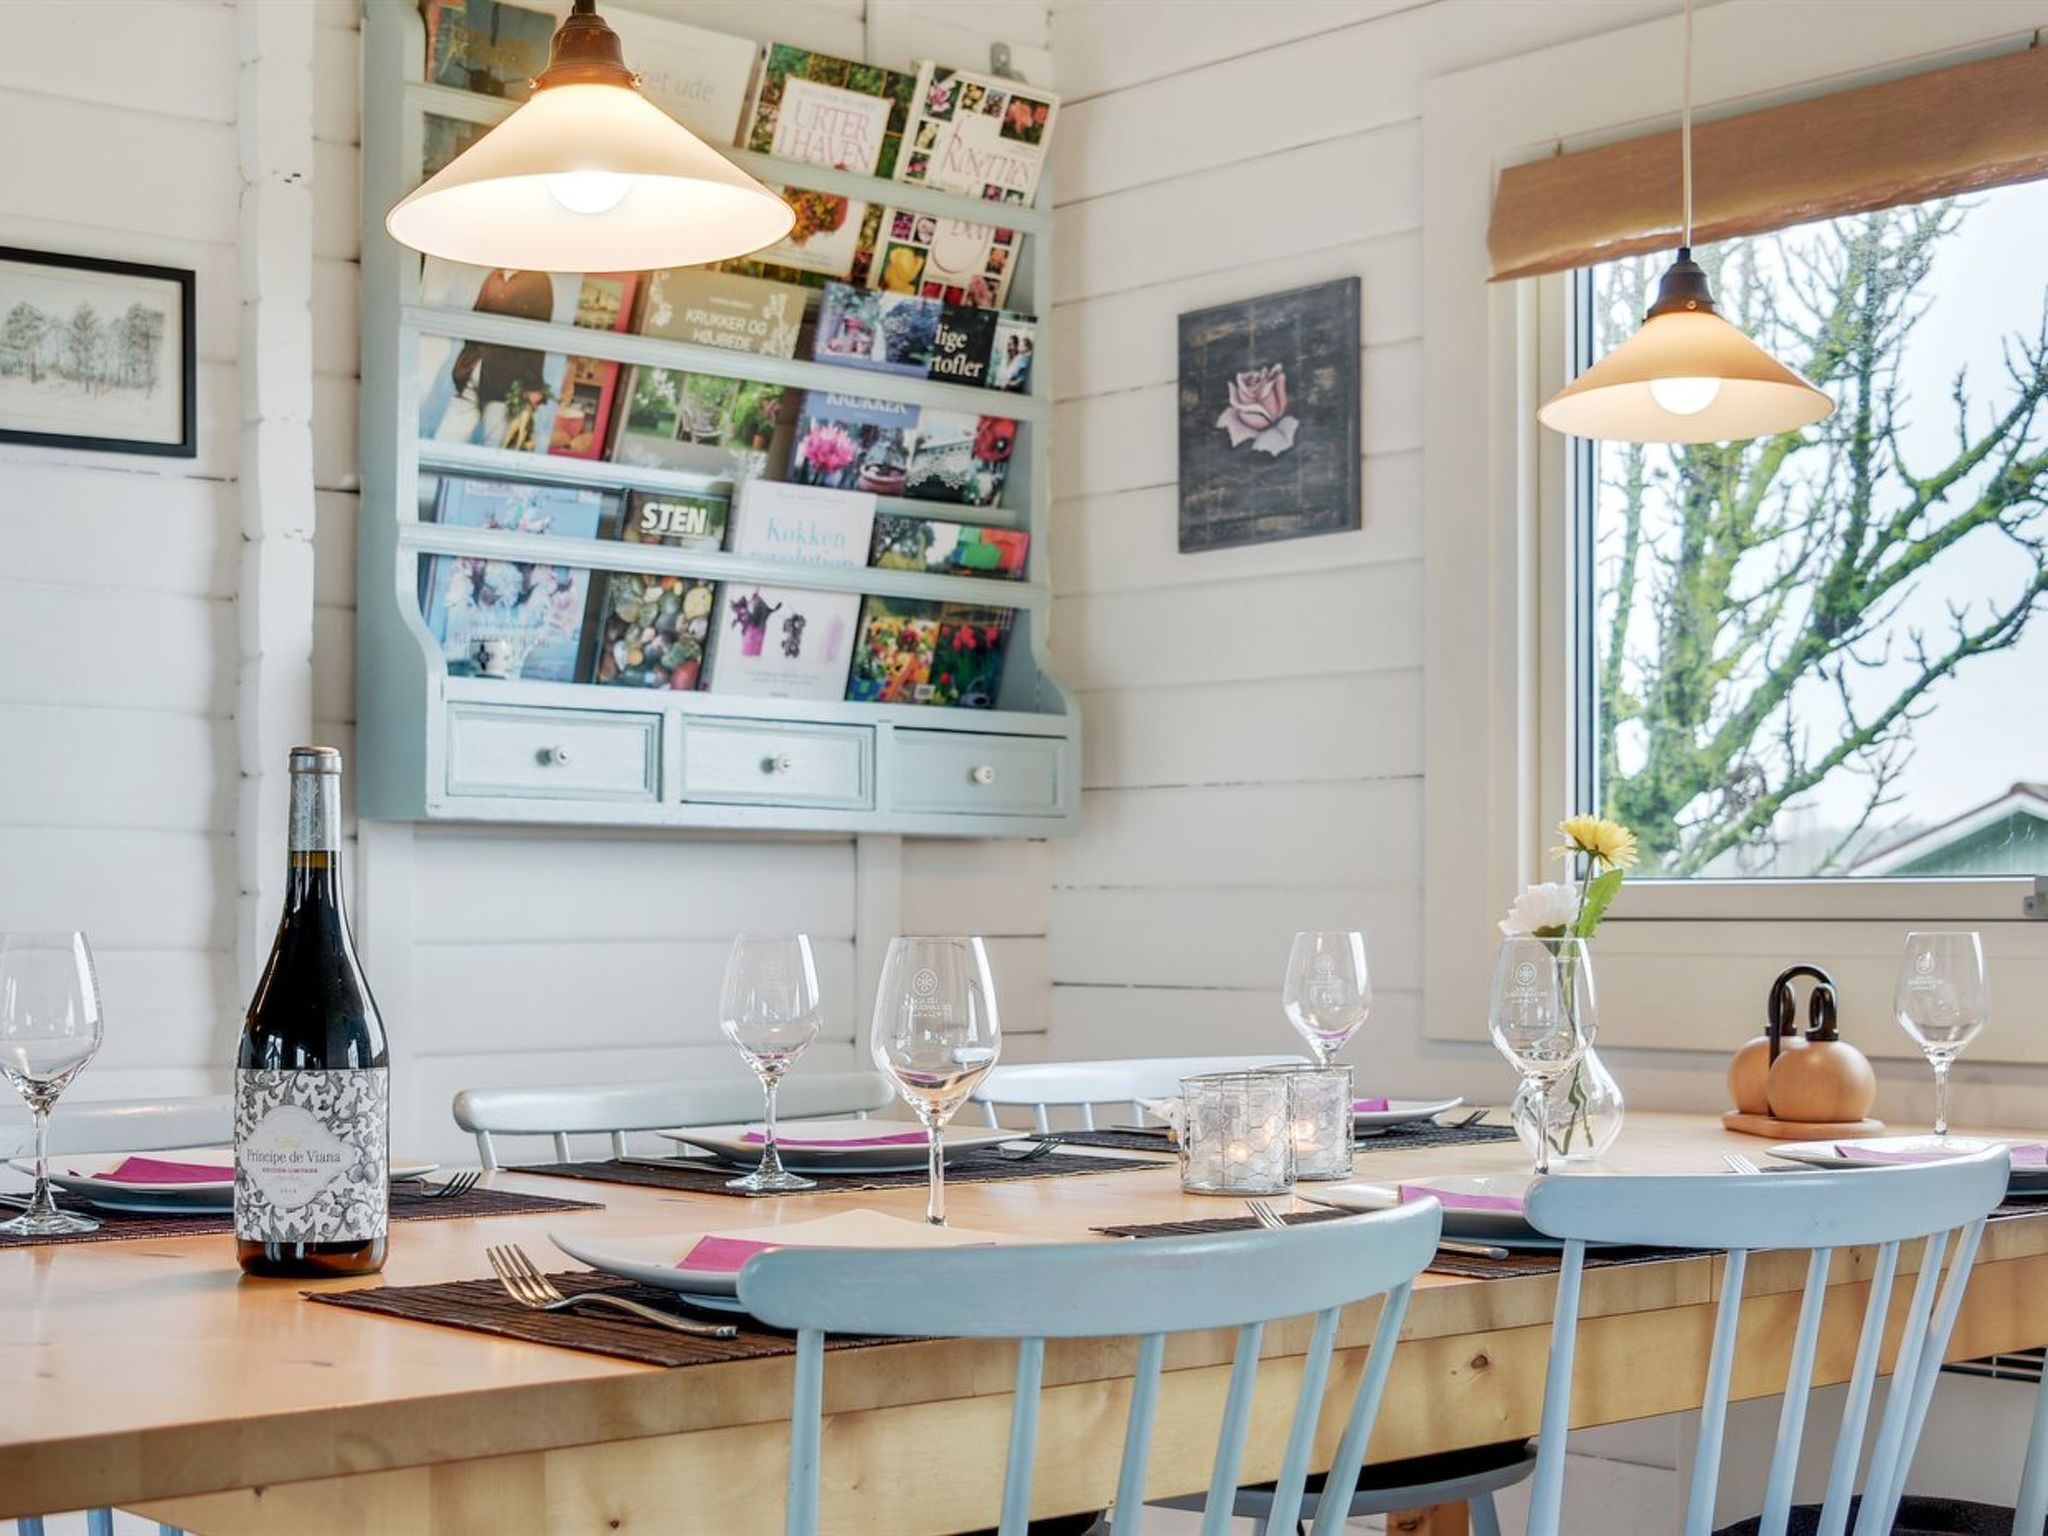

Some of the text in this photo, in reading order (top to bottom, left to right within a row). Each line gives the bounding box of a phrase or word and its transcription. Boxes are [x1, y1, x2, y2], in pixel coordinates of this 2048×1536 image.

[748, 319, 769, 336] OG
[640, 501, 707, 535] STEN
[288, 1150, 304, 1164] de
[306, 1149, 341, 1164] Viana
